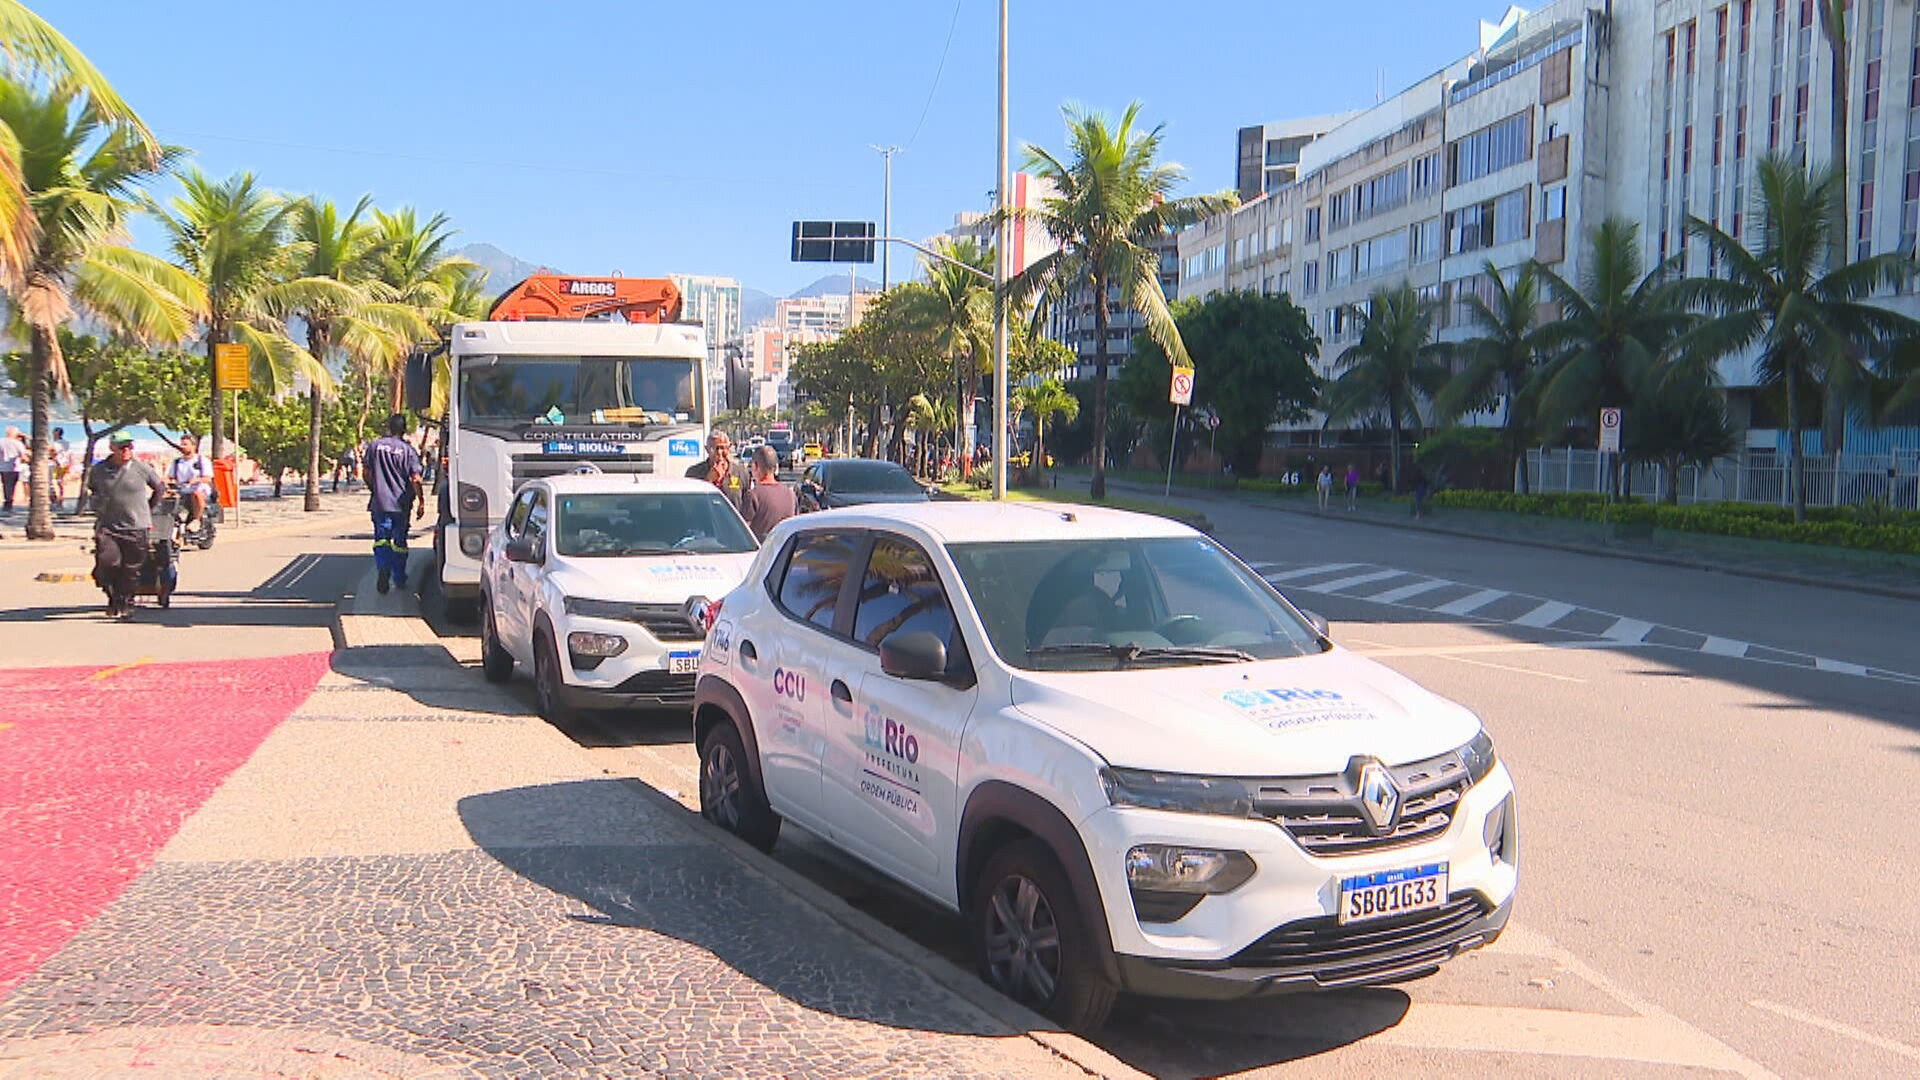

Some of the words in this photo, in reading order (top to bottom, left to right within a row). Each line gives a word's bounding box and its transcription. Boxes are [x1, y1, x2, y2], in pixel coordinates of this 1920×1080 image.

[570, 281, 616, 297] ARGOS
[523, 432, 642, 441] CONSTELLATION
[578, 442, 619, 453] RIOLUZ
[1281, 471, 1299, 485] 46
[774, 667, 805, 702] CCU
[885, 717, 920, 764] Rio
[865, 751, 920, 783] PREFEITURA
[860, 780, 886, 800] ORDEM
[887, 789, 918, 814] PÚBLICA
[1350, 878, 1436, 917] SBQ1G33
